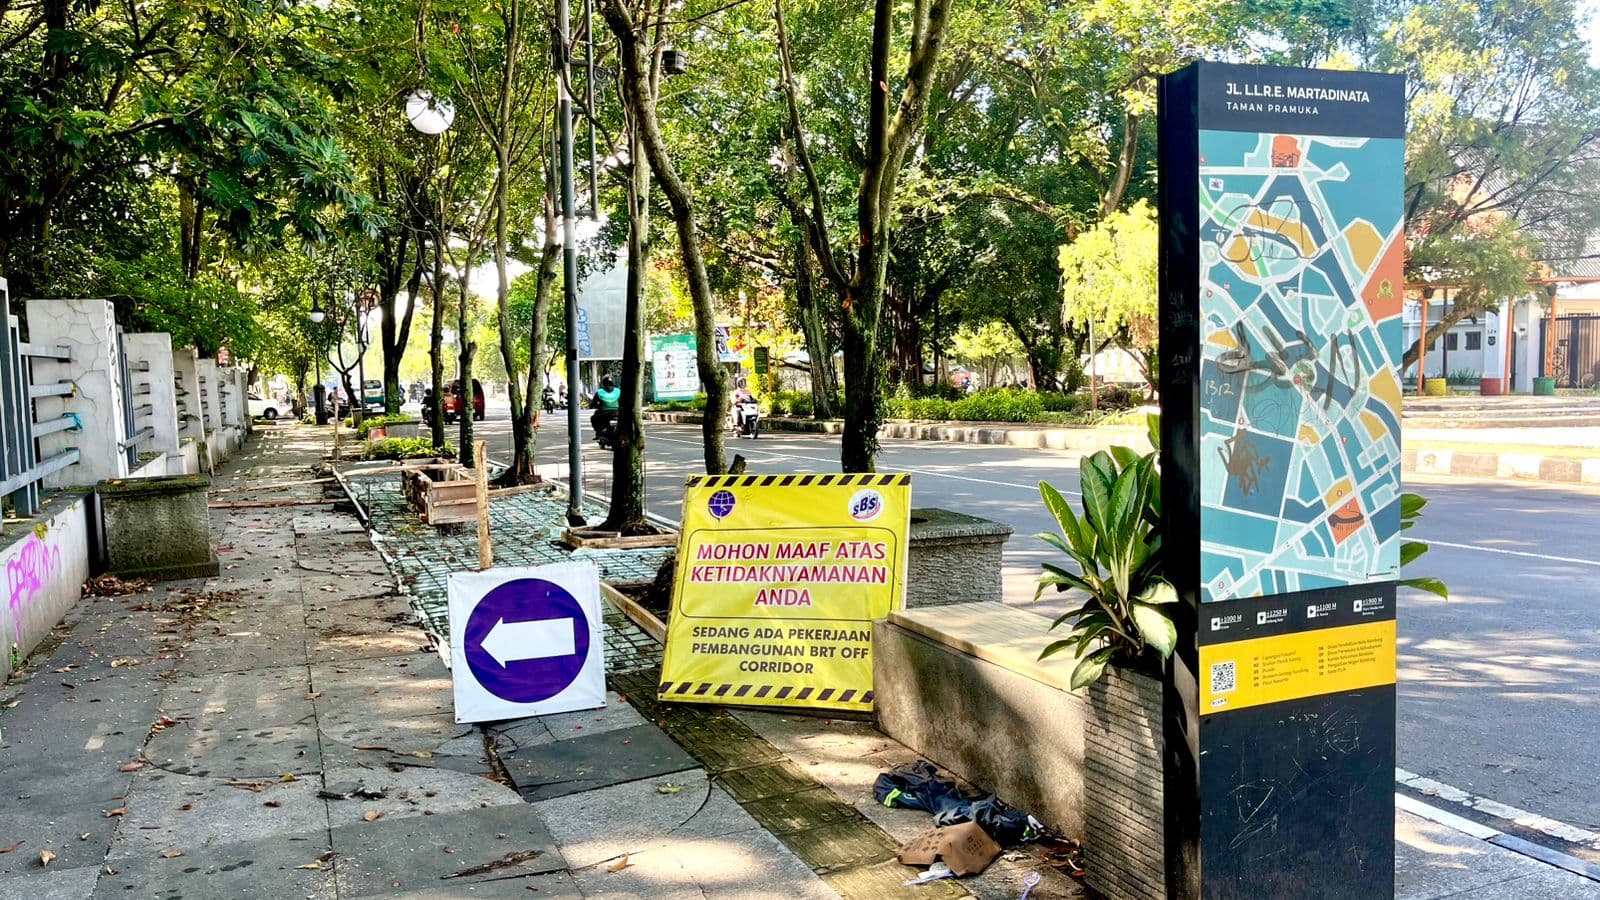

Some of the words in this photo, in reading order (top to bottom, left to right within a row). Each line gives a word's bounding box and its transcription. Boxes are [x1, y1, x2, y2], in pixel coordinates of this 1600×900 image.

[1226, 83, 1242, 96] JL.
[1244, 84, 1284, 98] L.L.R.E.
[1287, 86, 1370, 103] MARTADINATA
[1226, 102, 1263, 112] TAMAN
[1268, 104, 1319, 114] PRAMUKA
[696, 544, 770, 560] MOHON
[775, 542, 830, 559] MAAF
[835, 542, 886, 560] ATAS
[690, 566, 887, 584] KETIDAKNYAMANAN
[755, 589, 812, 606] ANDA
[692, 626, 750, 638] SEDANG
[754, 628, 784, 639] ADA
[788, 629, 871, 642] PEKERJAAN
[692, 643, 805, 656] PEMBANGUNAN
[810, 646, 837, 658] BRT
[841, 647, 869, 659] OFF
[740, 661, 814, 674] CORRIDOR
